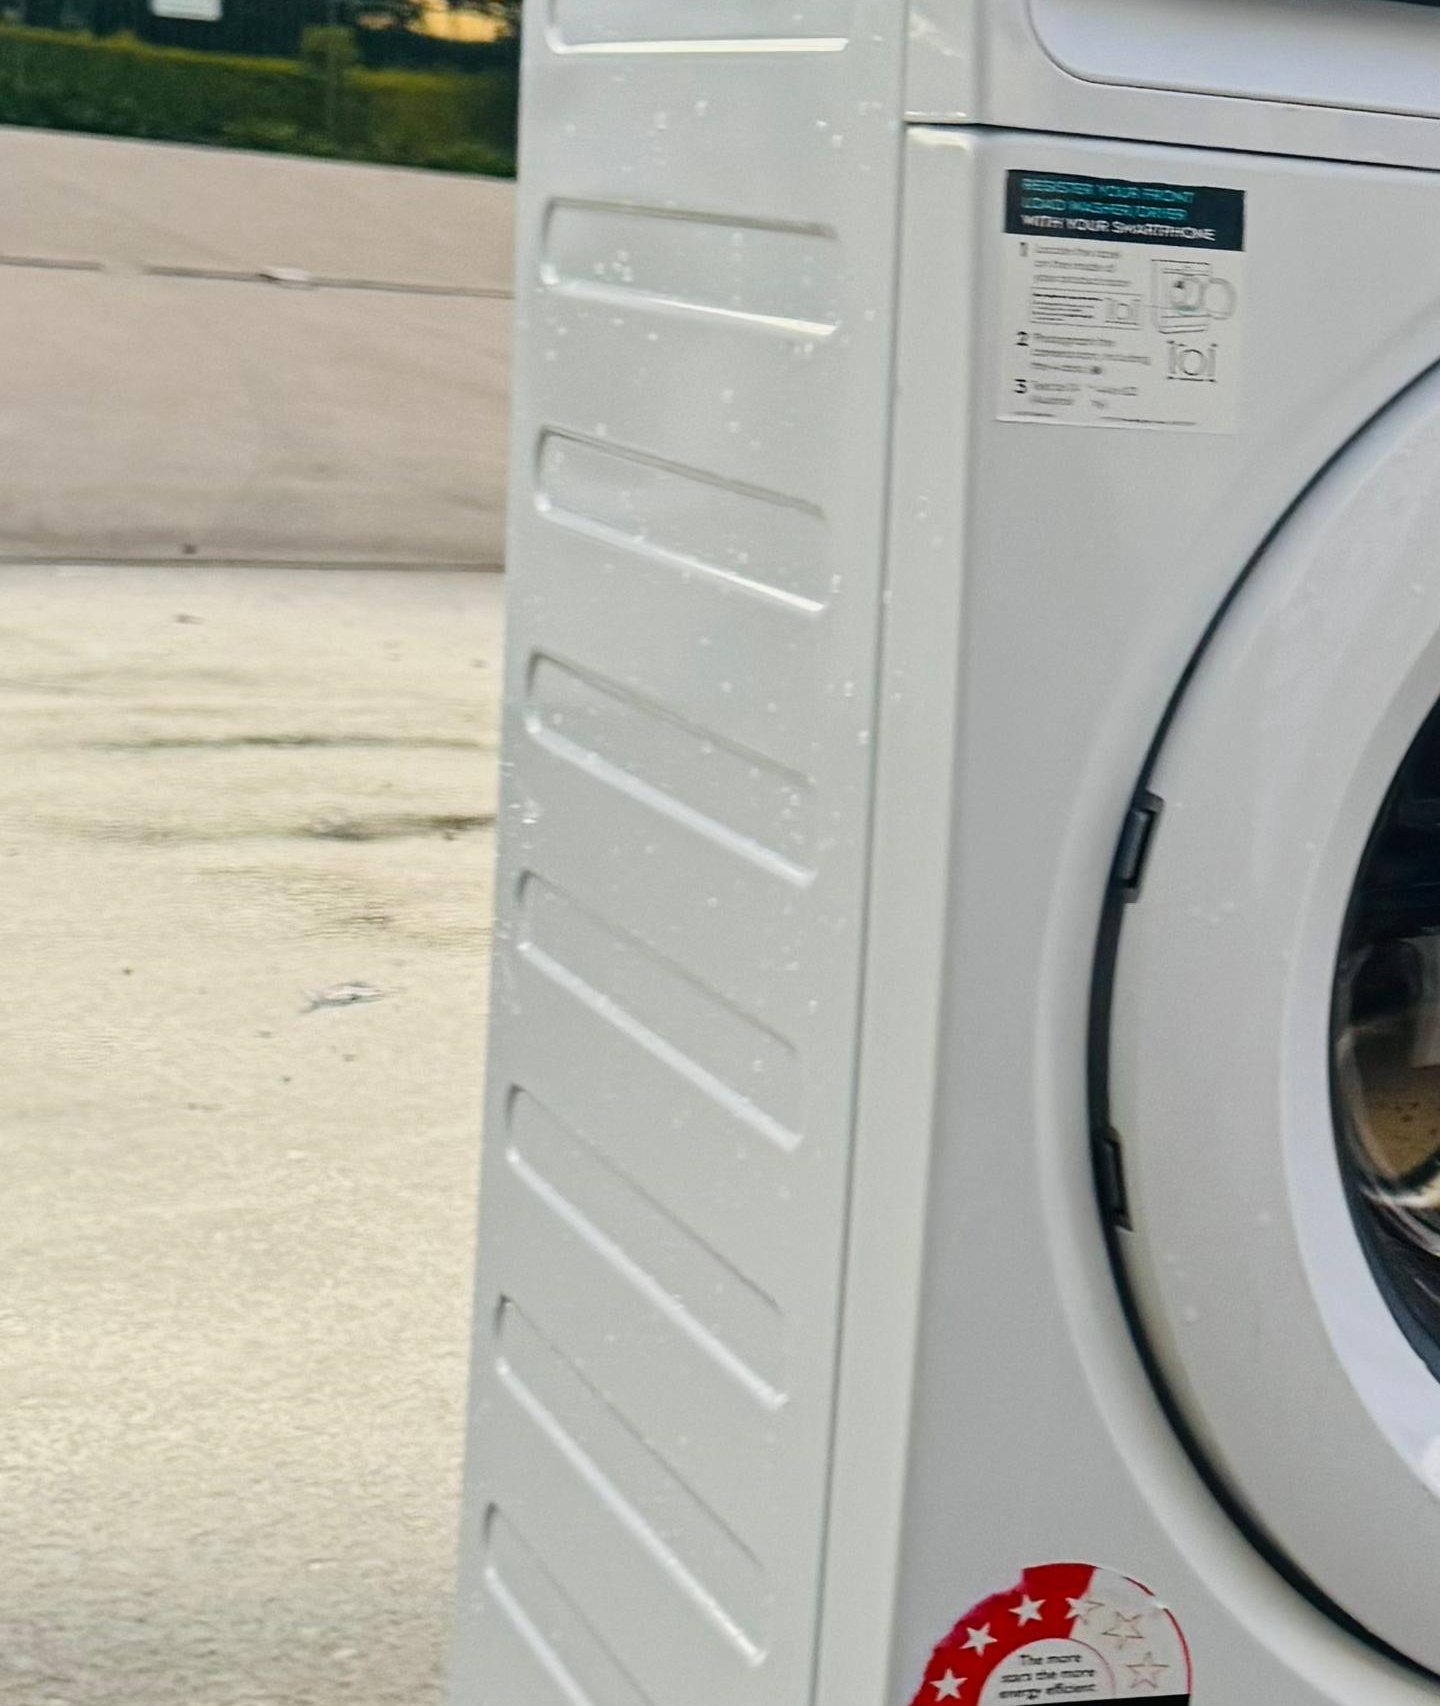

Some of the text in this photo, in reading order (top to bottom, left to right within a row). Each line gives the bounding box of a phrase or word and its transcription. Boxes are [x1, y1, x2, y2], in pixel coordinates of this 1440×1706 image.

[1016, 331, 1030, 347] 2
[1014, 378, 1029, 394] 3
[1019, 1654, 1082, 1666] The more
[1060, 1669, 1095, 1679] more
